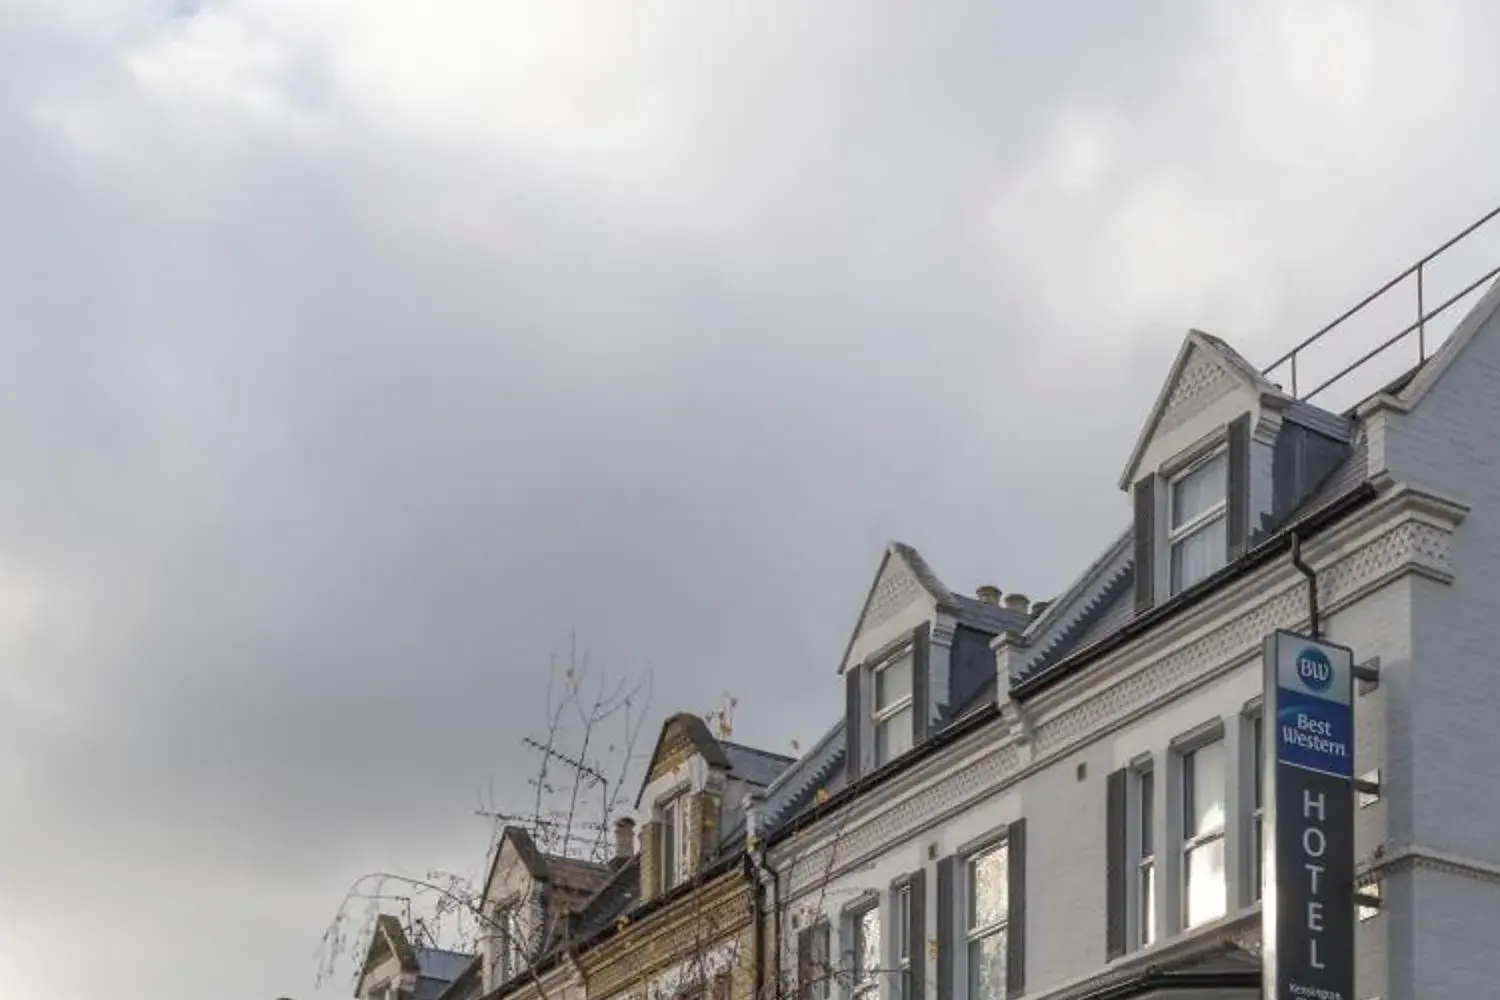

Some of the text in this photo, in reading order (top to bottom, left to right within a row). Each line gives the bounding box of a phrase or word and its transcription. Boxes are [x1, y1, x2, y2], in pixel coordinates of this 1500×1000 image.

[1300, 657, 1329, 681] BW
[1297, 713, 1332, 736] Best
[1282, 725, 1346, 757] Western
[1303, 789, 1326, 969] HOTEL
